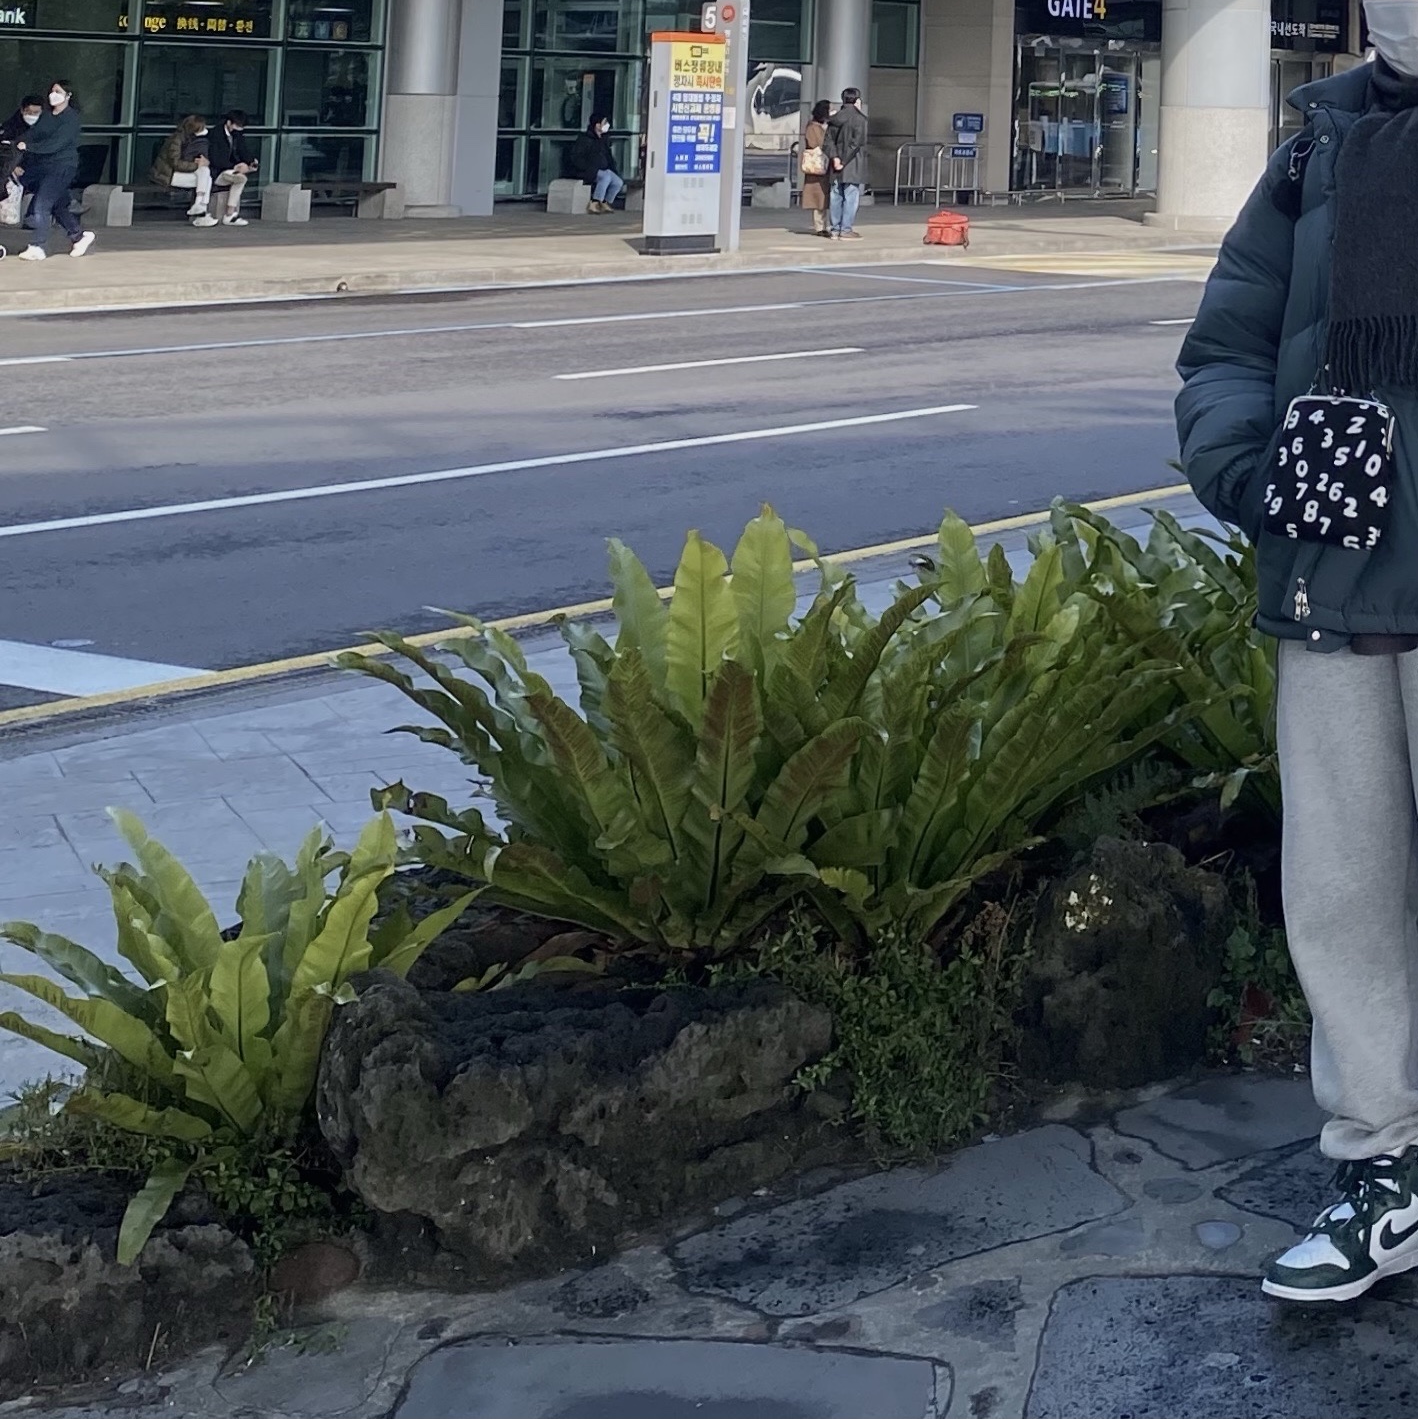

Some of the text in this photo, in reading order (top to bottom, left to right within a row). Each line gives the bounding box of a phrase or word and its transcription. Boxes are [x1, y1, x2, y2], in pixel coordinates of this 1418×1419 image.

[705, 6, 717, 29] 5
[1287, 410, 1300, 429] 9
[1309, 409, 1325, 424] 4
[1346, 416, 1366, 434] 2
[1292, 437, 1303, 455] 6
[1321, 428, 1334, 448] 3
[1279, 446, 1288, 466] 3
[1334, 447, 1350, 466] 5
[1355, 440, 1367, 458] 1
[1296, 460, 1308, 477] 0
[1365, 454, 1381, 477] 0
[1296, 483, 1308, 500] 7
[1316, 473, 1328, 491] 2
[1329, 482, 1344, 501] 6
[1264, 484, 1276, 503] 5
[1370, 486, 1388, 507] 4
[1269, 497, 1283, 515] 9
[1303, 500, 1319, 522] 8
[1343, 497, 1358, 518] 2
[1319, 517, 1331, 534] 7
